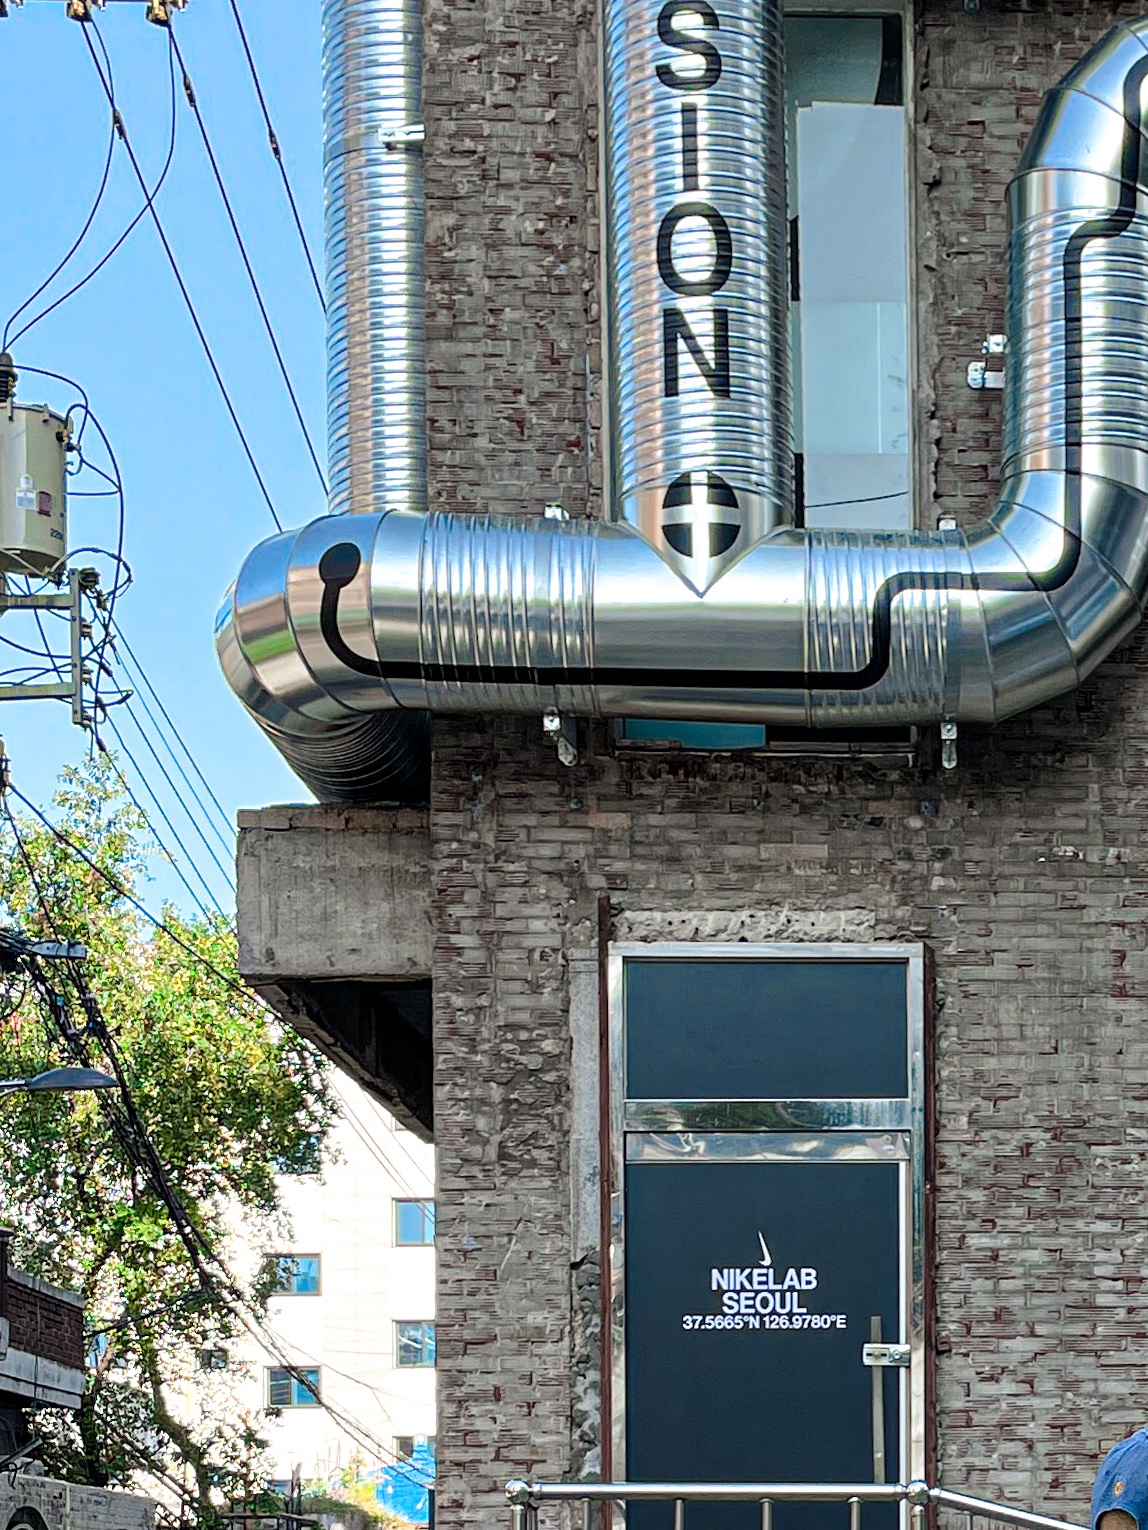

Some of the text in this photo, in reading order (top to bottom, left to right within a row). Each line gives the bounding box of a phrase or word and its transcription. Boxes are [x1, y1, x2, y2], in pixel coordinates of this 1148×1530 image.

[711, 1268, 818, 1291] NIKELAB
[722, 1291, 808, 1315] SEOUL
[682, 1314, 847, 1330] 37.5665°N 126.9780°E
